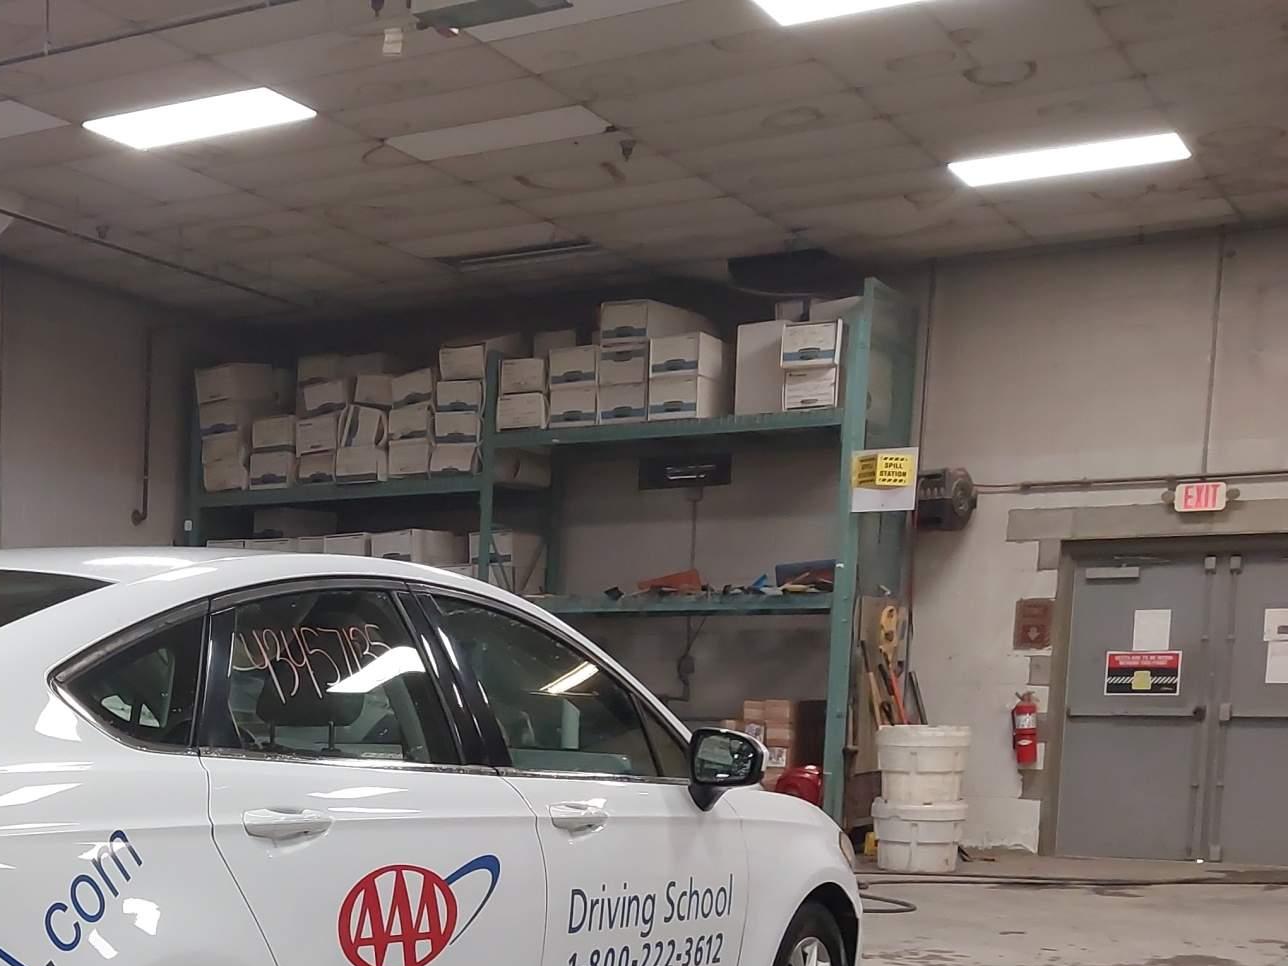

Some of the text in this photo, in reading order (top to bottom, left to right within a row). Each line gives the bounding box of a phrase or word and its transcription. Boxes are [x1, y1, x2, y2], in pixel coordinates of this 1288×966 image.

[1183, 484, 1221, 510] EXIT
[568, 873, 733, 938] Driving School
